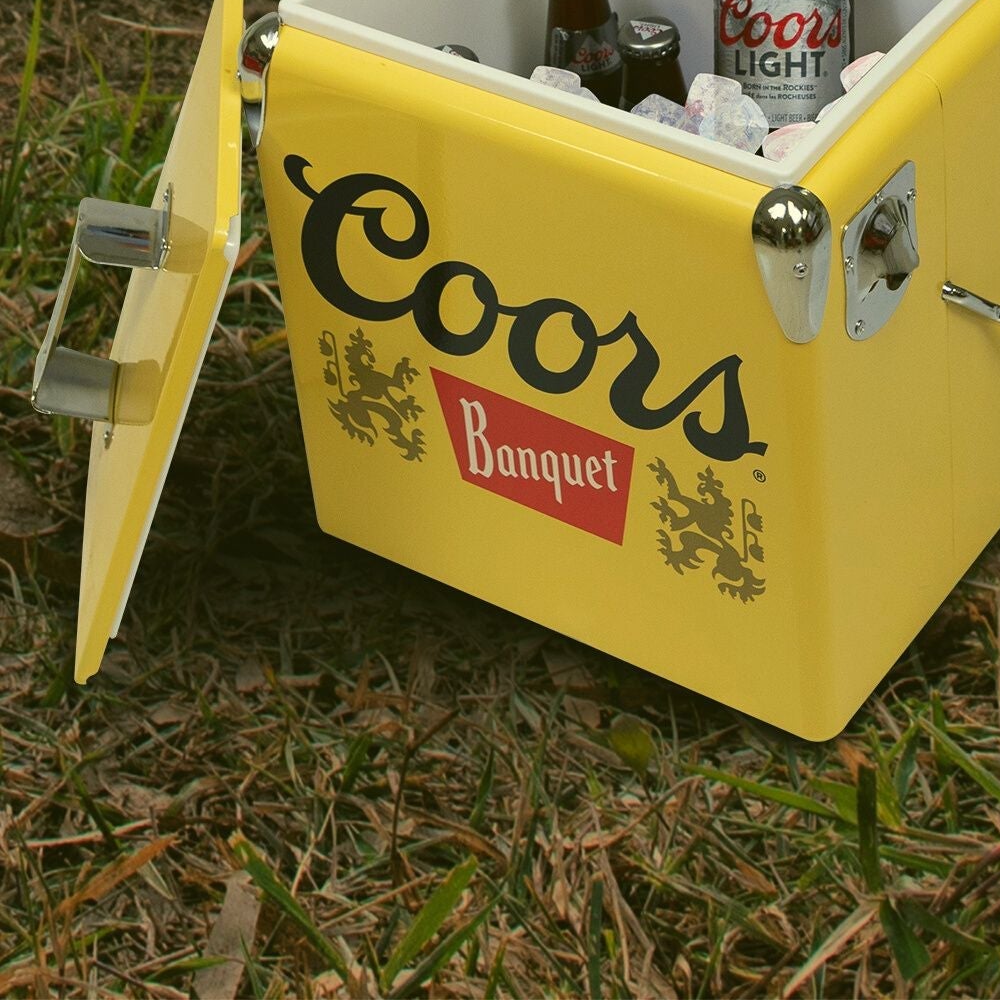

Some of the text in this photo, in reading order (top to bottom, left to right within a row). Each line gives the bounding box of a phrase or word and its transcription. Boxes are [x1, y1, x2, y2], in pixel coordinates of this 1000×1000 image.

[735, 50, 826, 77] LIGHT
[283, 154, 768, 462] Coors
[458, 397, 618, 505] Banquet
